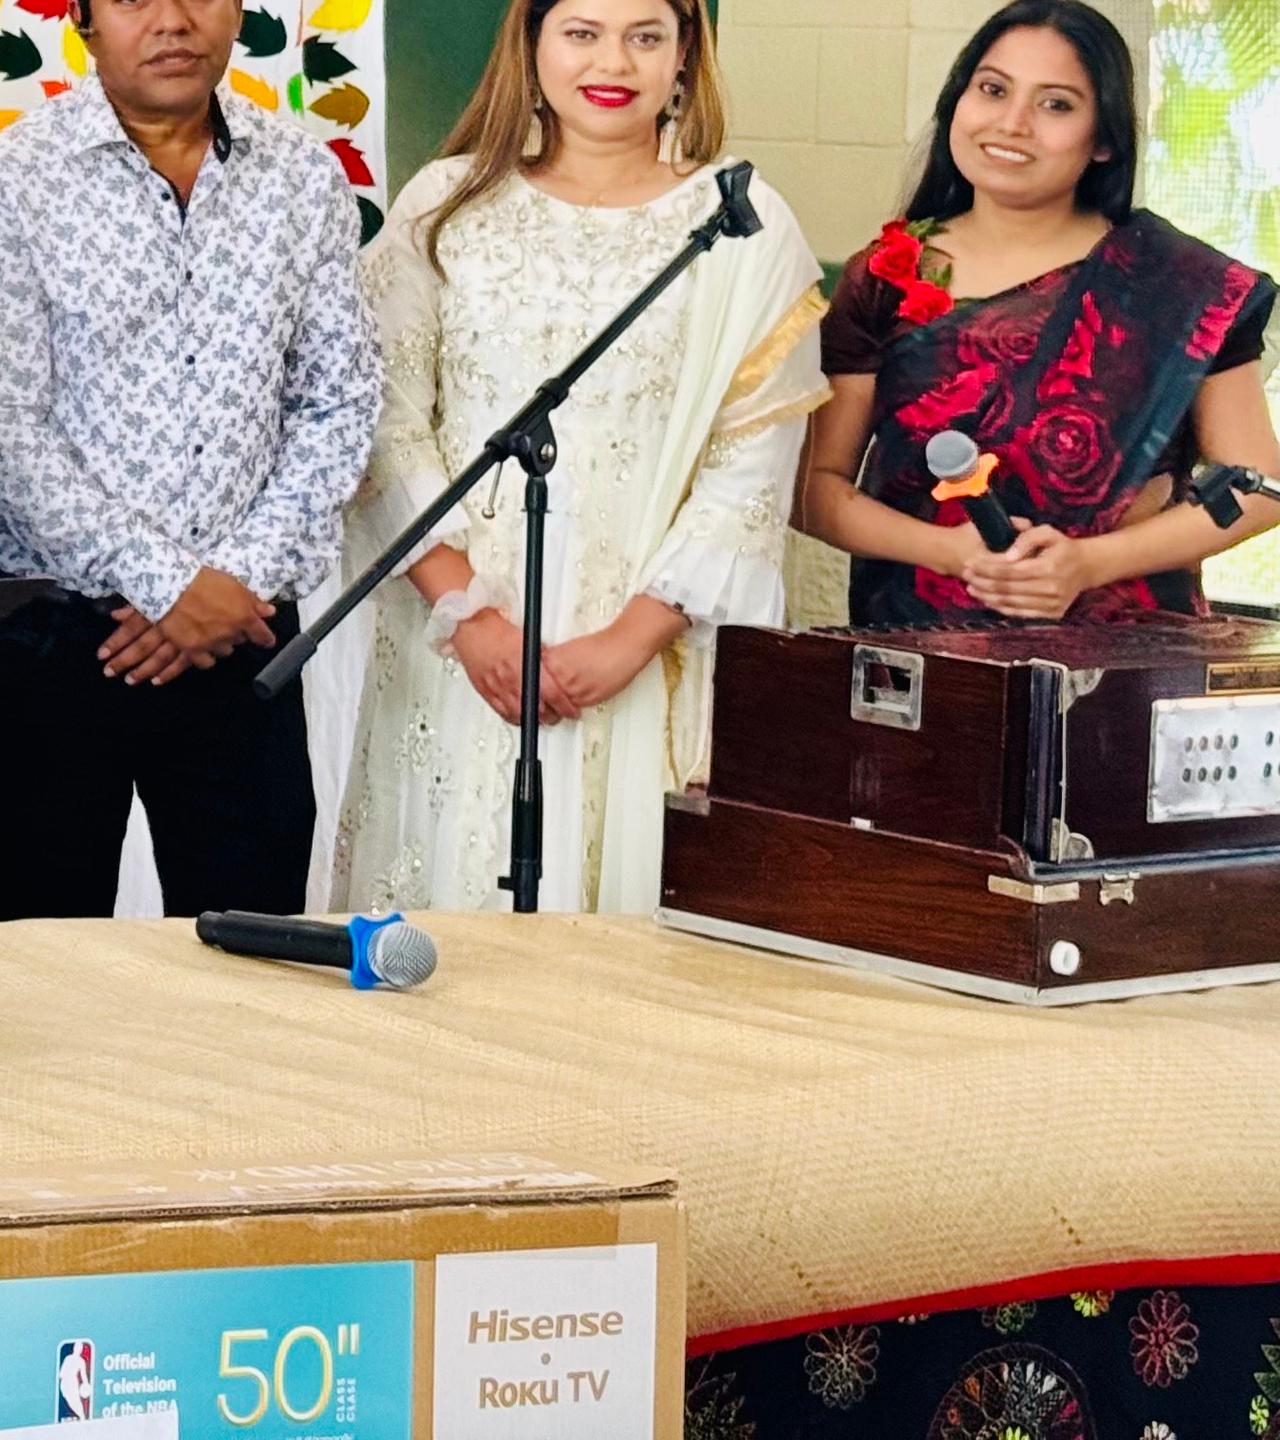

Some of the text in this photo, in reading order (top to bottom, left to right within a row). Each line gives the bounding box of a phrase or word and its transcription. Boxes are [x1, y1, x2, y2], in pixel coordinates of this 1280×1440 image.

[467, 1309, 623, 1344] Hisense
[102, 1352, 155, 1372] Official
[217, 1323, 360, 1427] 50"
[102, 1376, 178, 1395] Television
[478, 1369, 610, 1409] Roku TV
[102, 1402, 118, 1418] of
[120, 1401, 144, 1417] the
